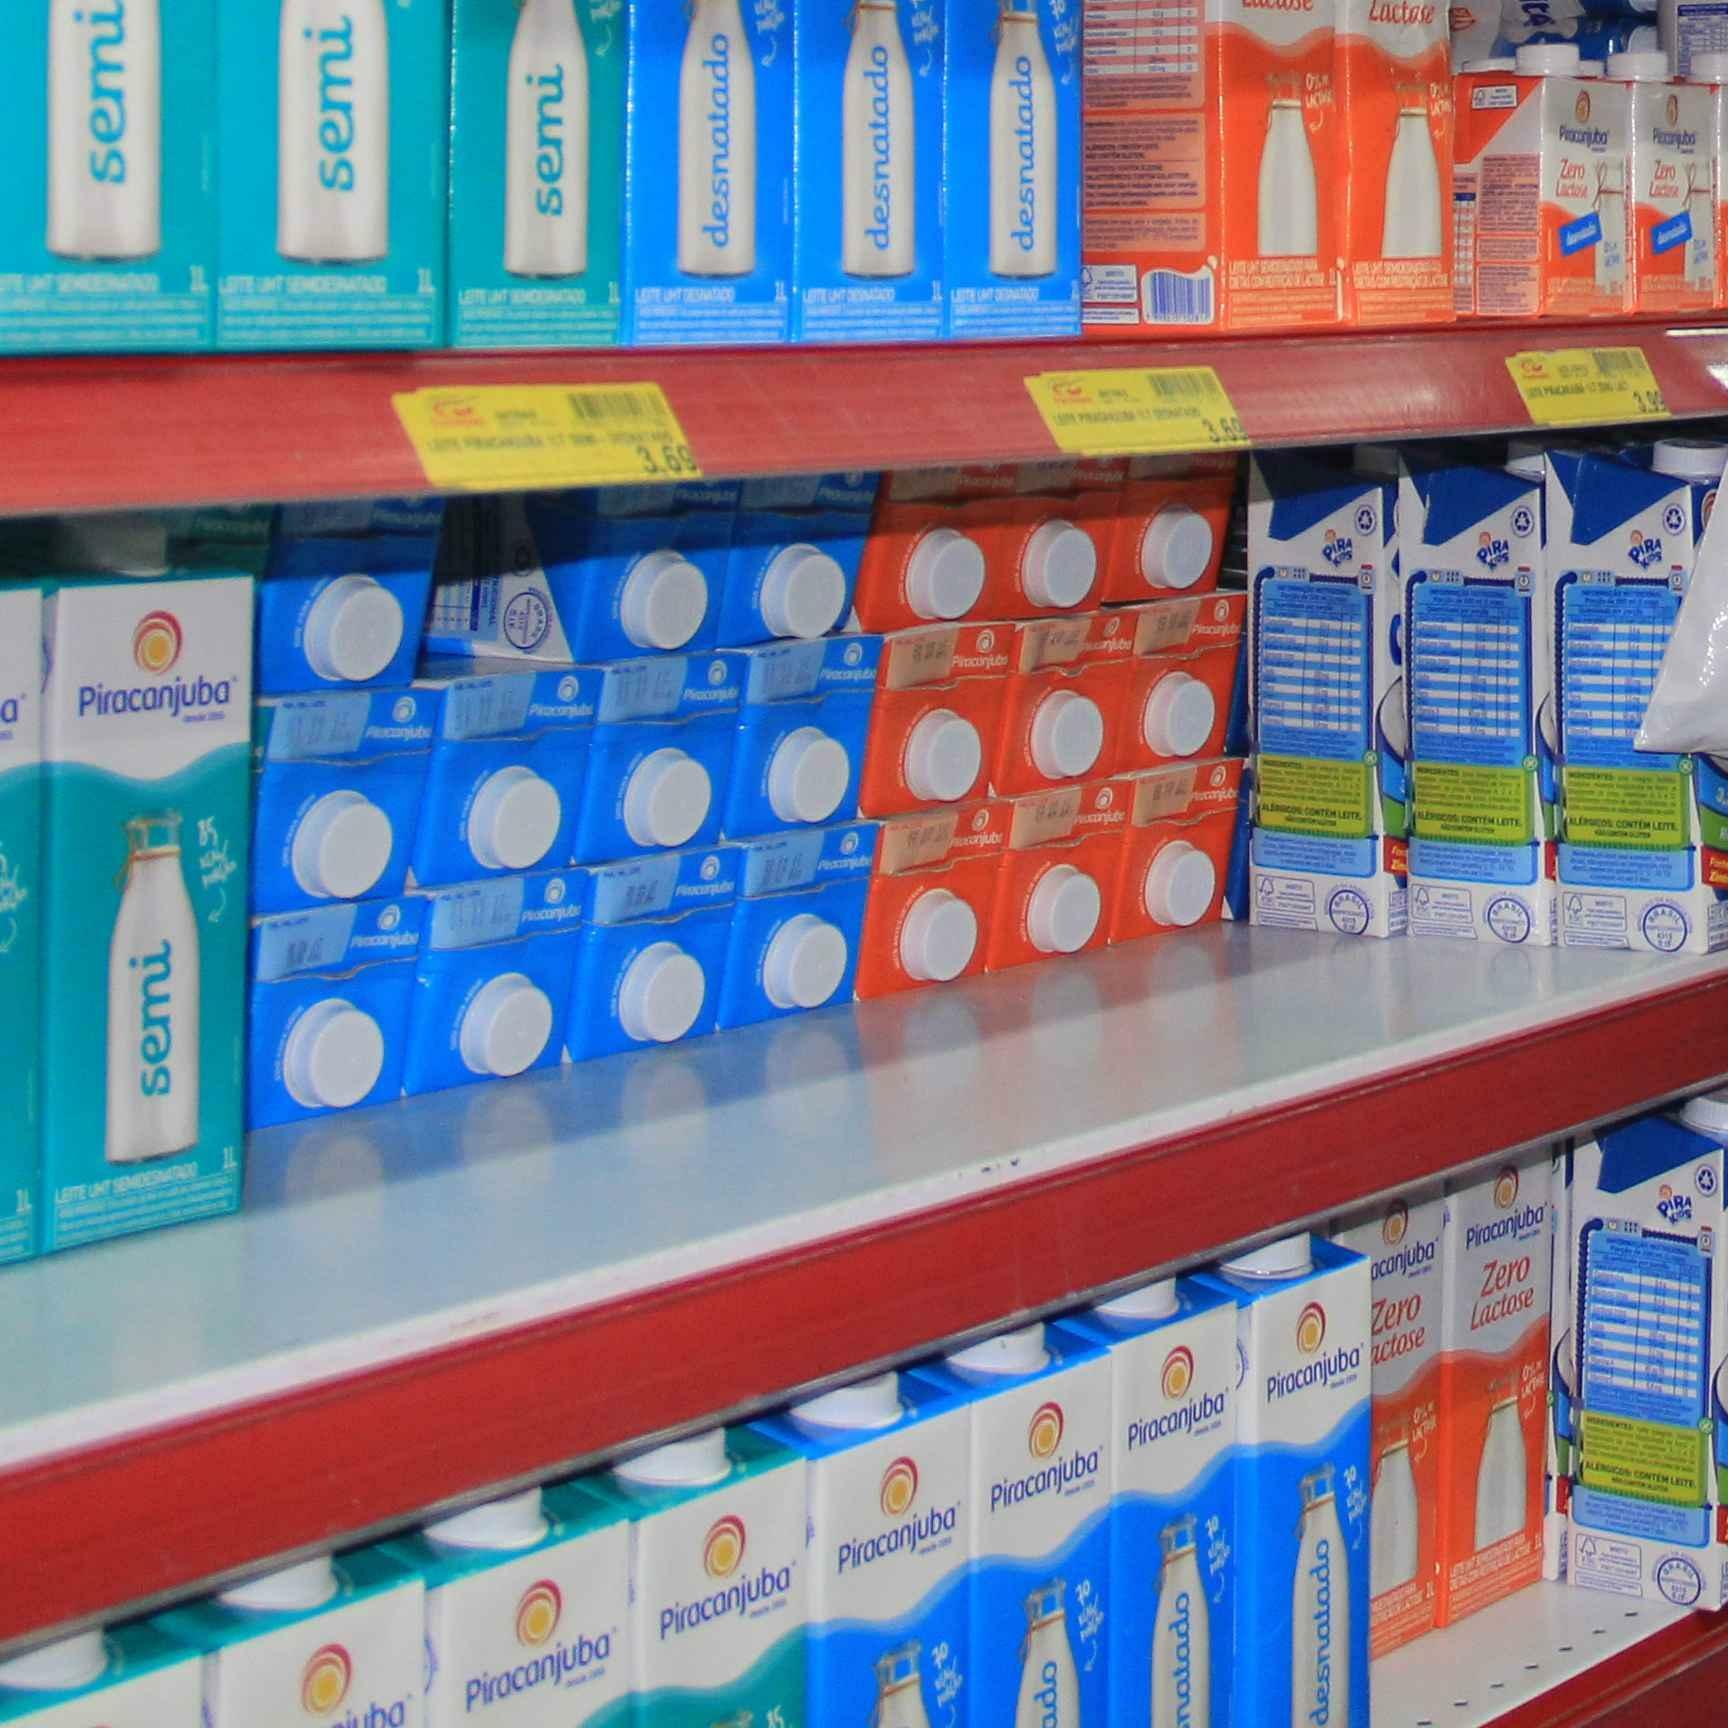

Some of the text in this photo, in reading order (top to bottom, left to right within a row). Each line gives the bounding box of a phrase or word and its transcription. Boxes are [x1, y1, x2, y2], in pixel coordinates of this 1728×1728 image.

[303, 12, 353, 192] semi
[524, 62, 563, 216] semi
[701, 32, 731, 250] desnatado
[866, 44, 890, 252] desnatado
[1011, 54, 1033, 253] desnatado
[1633, 391, 1667, 415] 3.99
[1322, 536, 1353, 562] PIRA
[1332, 549, 1353, 570] KIDS
[1476, 537, 1509, 564] PIRA
[1486, 552, 1509, 571] KIDS
[1627, 536, 1663, 564] PIRA
[75, 678, 232, 718] Piracanjuba
[128, 935, 171, 1095] semi
[1464, 1203, 1546, 1252] Piracanjuba
[1656, 1192, 1691, 1221] PIRA
[1480, 1254, 1532, 1296] Zero
[1370, 1291, 1422, 1336] Zero
[1470, 1286, 1534, 1332] Lactose
[1370, 1324, 1426, 1368] actose
[1266, 1346, 1364, 1404] Piracanjuba
[1127, 1388, 1228, 1452] Piracanjuba
[990, 1447, 1101, 1514] Piracanjuba
[836, 1503, 960, 1575] Piracanjuba
[658, 1562, 793, 1641] Piracanjuba
[465, 1630, 613, 1712] Piracanjuba
